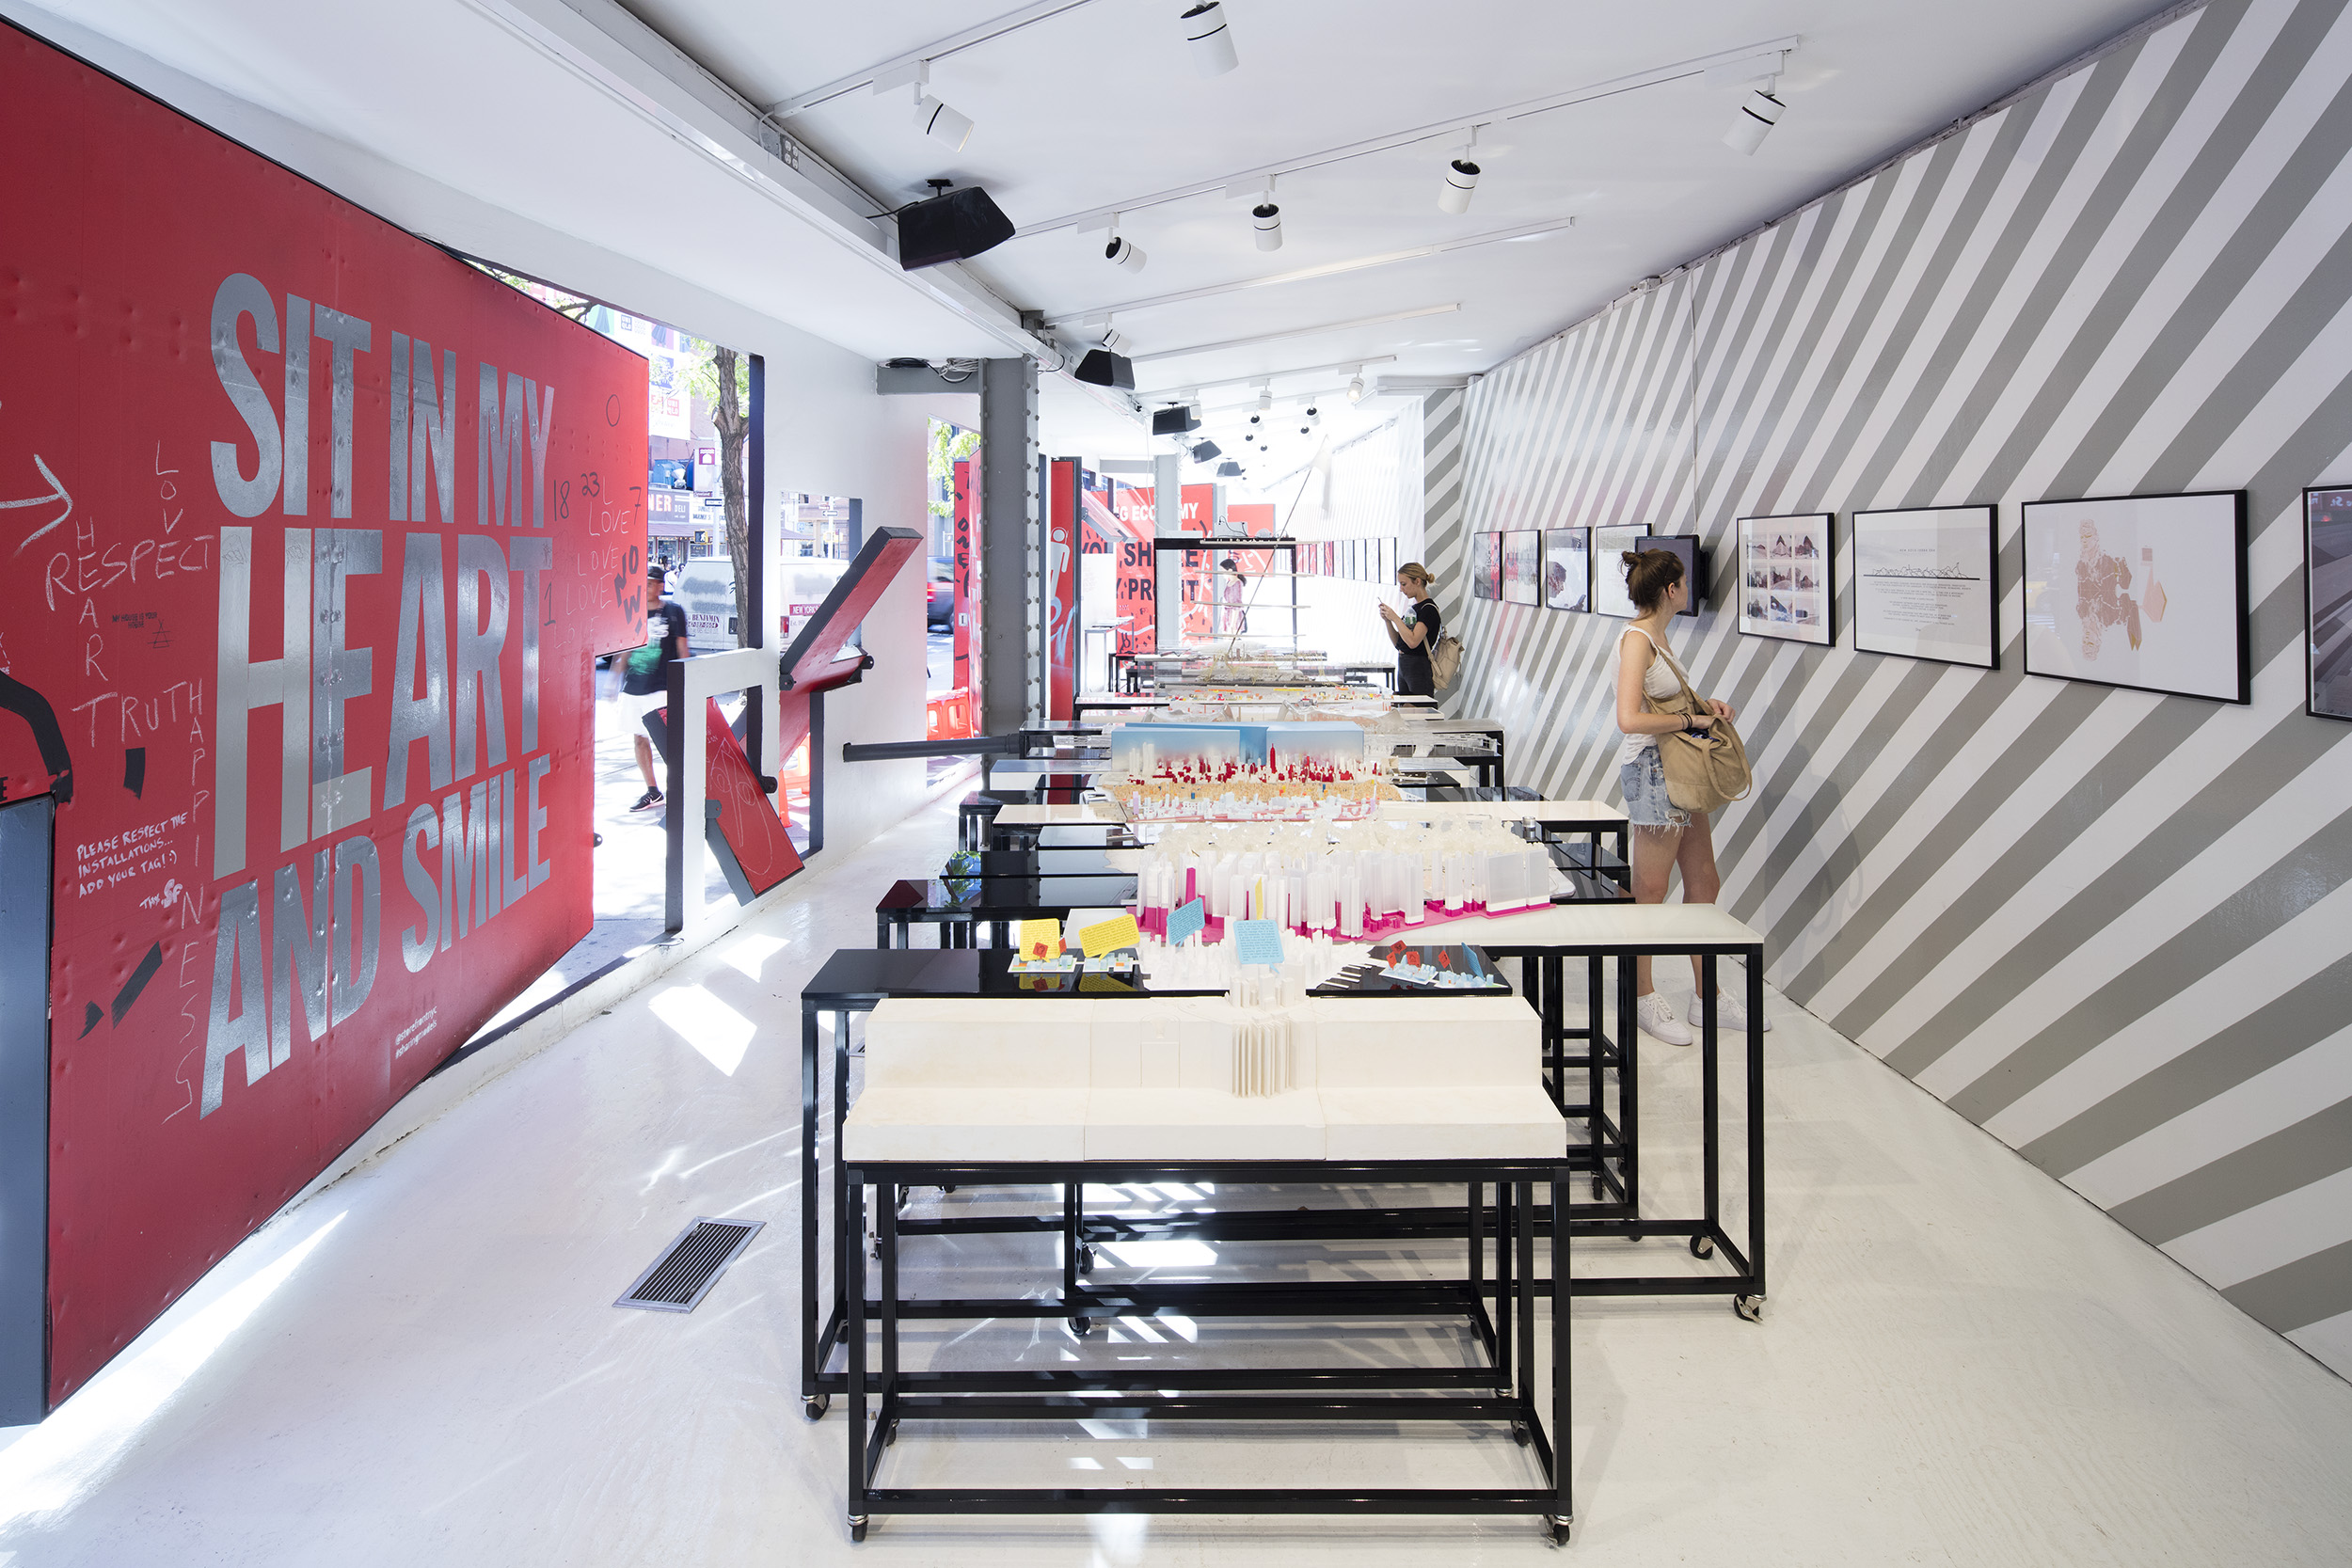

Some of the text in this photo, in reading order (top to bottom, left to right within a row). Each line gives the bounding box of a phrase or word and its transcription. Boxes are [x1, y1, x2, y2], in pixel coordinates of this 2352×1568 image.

[211, 273, 555, 529] SIT IN MY
[580, 472, 601, 498] 23
[629, 486, 642, 526] 7
[589, 501, 631, 537] LOVE
[45, 535, 215, 612] RESPECT
[578, 542, 619, 577] LOVE
[1124, 542, 1200, 567] SHE
[565, 573, 612, 616] LOVE
[72, 678, 203, 749] TRUTH
[214, 526, 553, 880] HEART
[77, 812, 188, 862] PLEASE RESPECT THE
[79, 837, 173, 879] INSTALLATIONS...
[79, 879, 104, 898] ADD
[108, 866, 136, 889] YOUR
[199, 752, 551, 1120] AND SMILE
